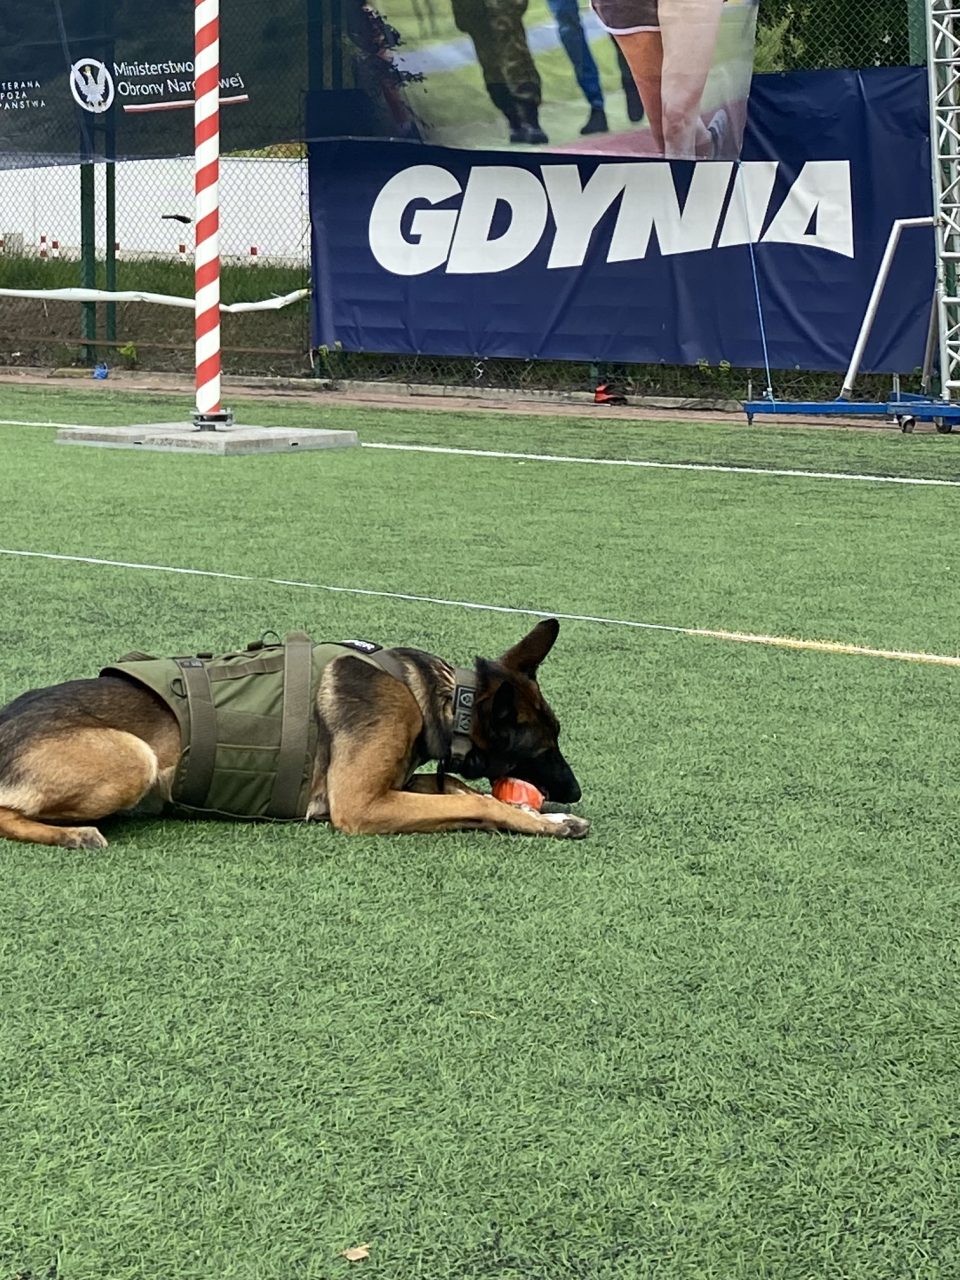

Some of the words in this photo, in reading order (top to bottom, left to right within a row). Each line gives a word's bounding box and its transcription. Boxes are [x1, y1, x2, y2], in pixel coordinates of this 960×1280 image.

[113, 60, 195, 77] Ministerstwo
[117, 81, 164, 96] Obrony
[166, 72, 245, 93] Narwej
[0, 90, 28, 100] POZA
[369, 160, 854, 276] GDYNIA
